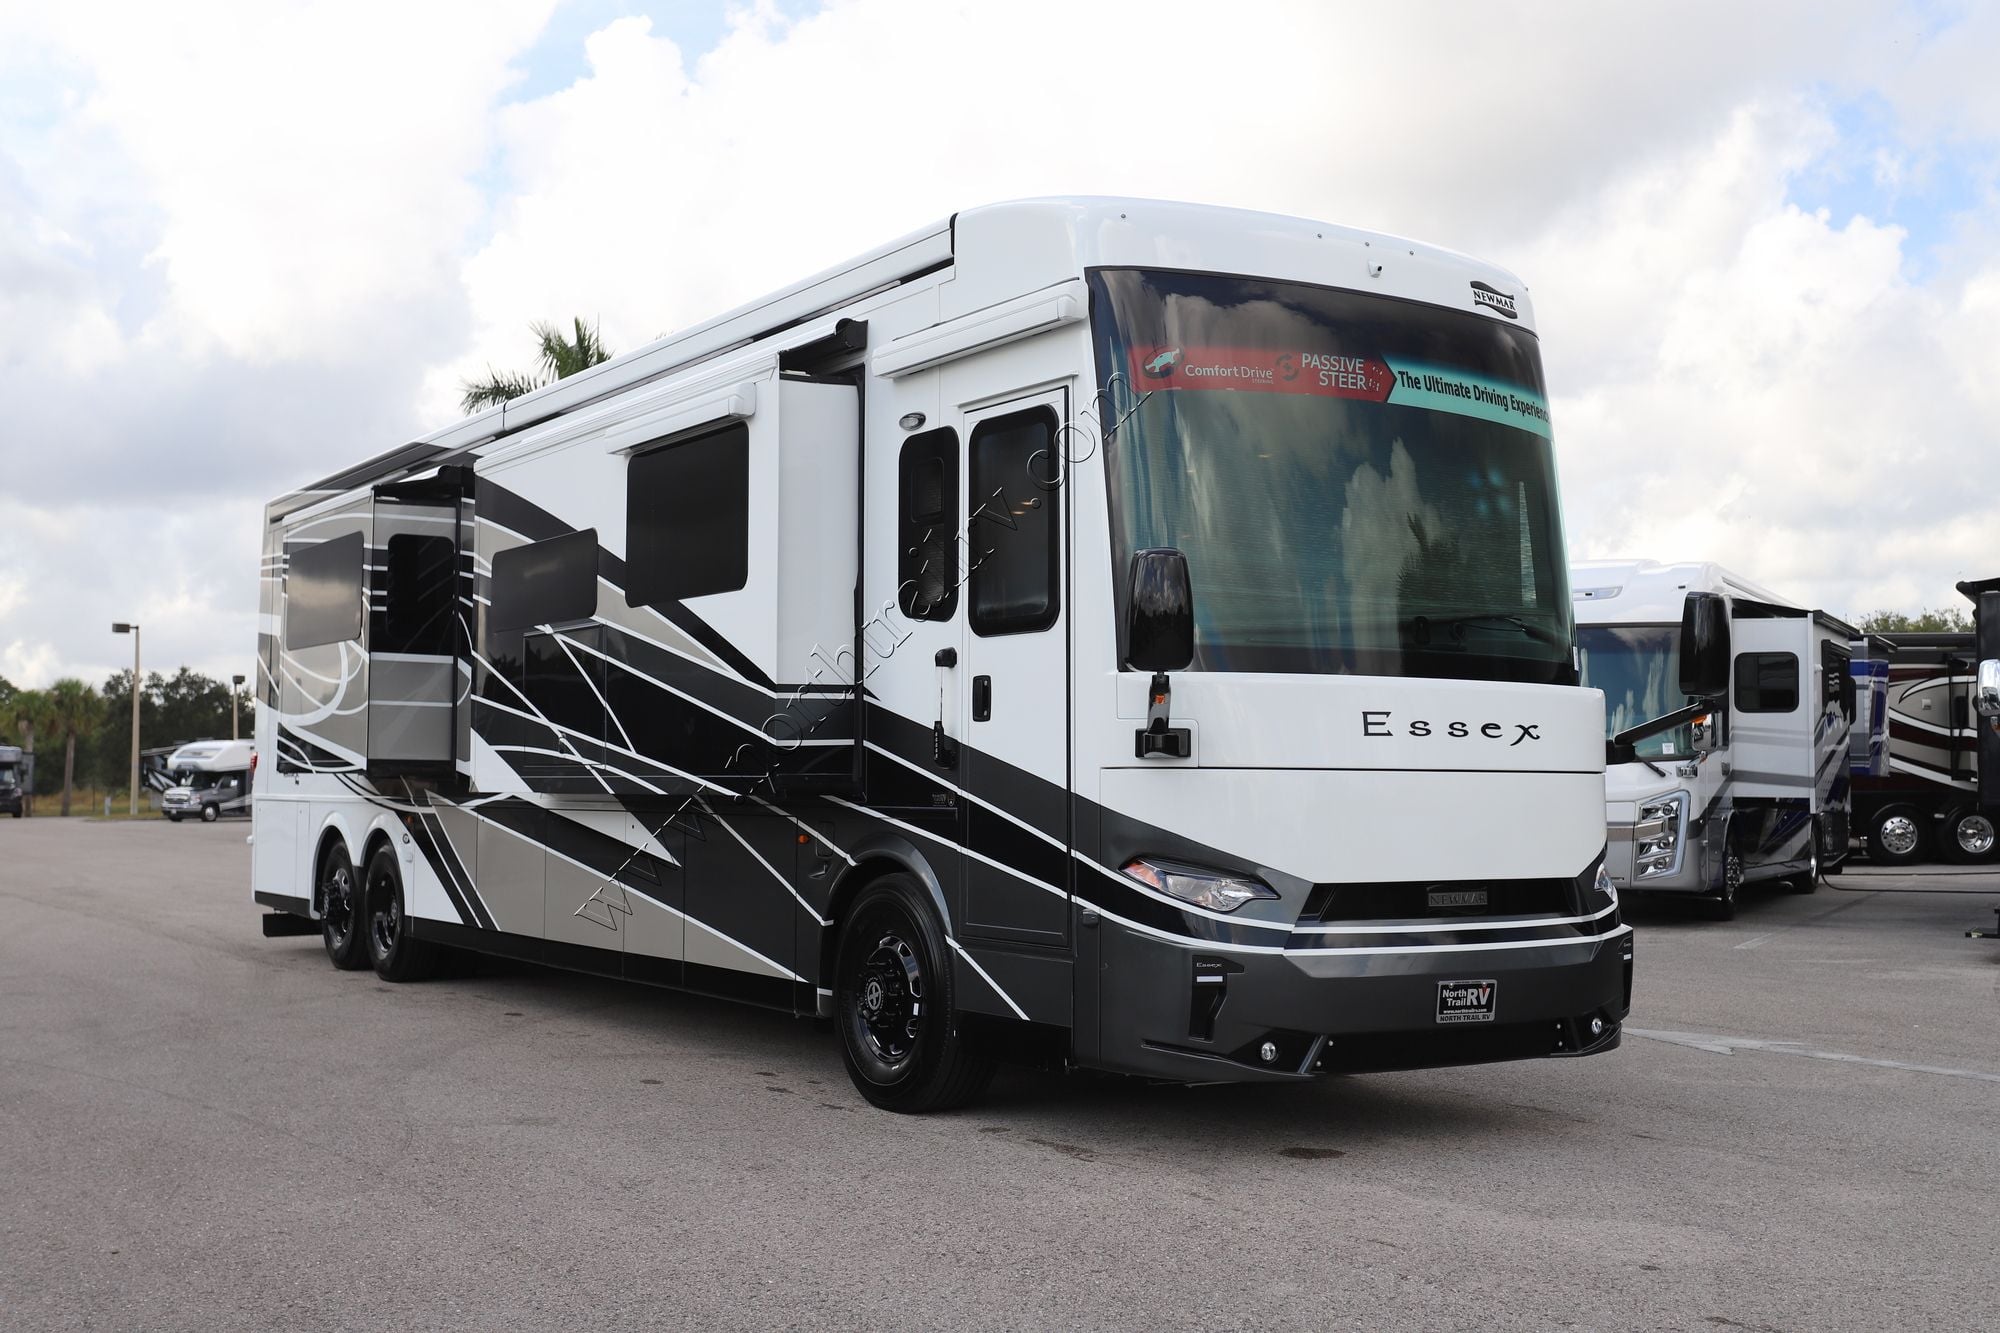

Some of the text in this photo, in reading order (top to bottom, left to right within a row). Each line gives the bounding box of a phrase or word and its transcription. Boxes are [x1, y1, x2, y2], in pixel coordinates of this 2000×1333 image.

[1472, 289, 1517, 311] NEWMAR
[1185, 364, 1273, 379] Comfort Drive
[1302, 353, 1365, 374] PASSIVE
[1319, 371, 1367, 390] STEER
[1398, 370, 1422, 390] The
[1424, 374, 1472, 400] Ultimate
[1473, 384, 1509, 412] Driving
[1361, 711, 1541, 747] Essex
[1430, 892, 1487, 905] NEWMAR
[1442, 988, 1490, 1005] North RV
[1446, 998, 1466, 1006] Trail
